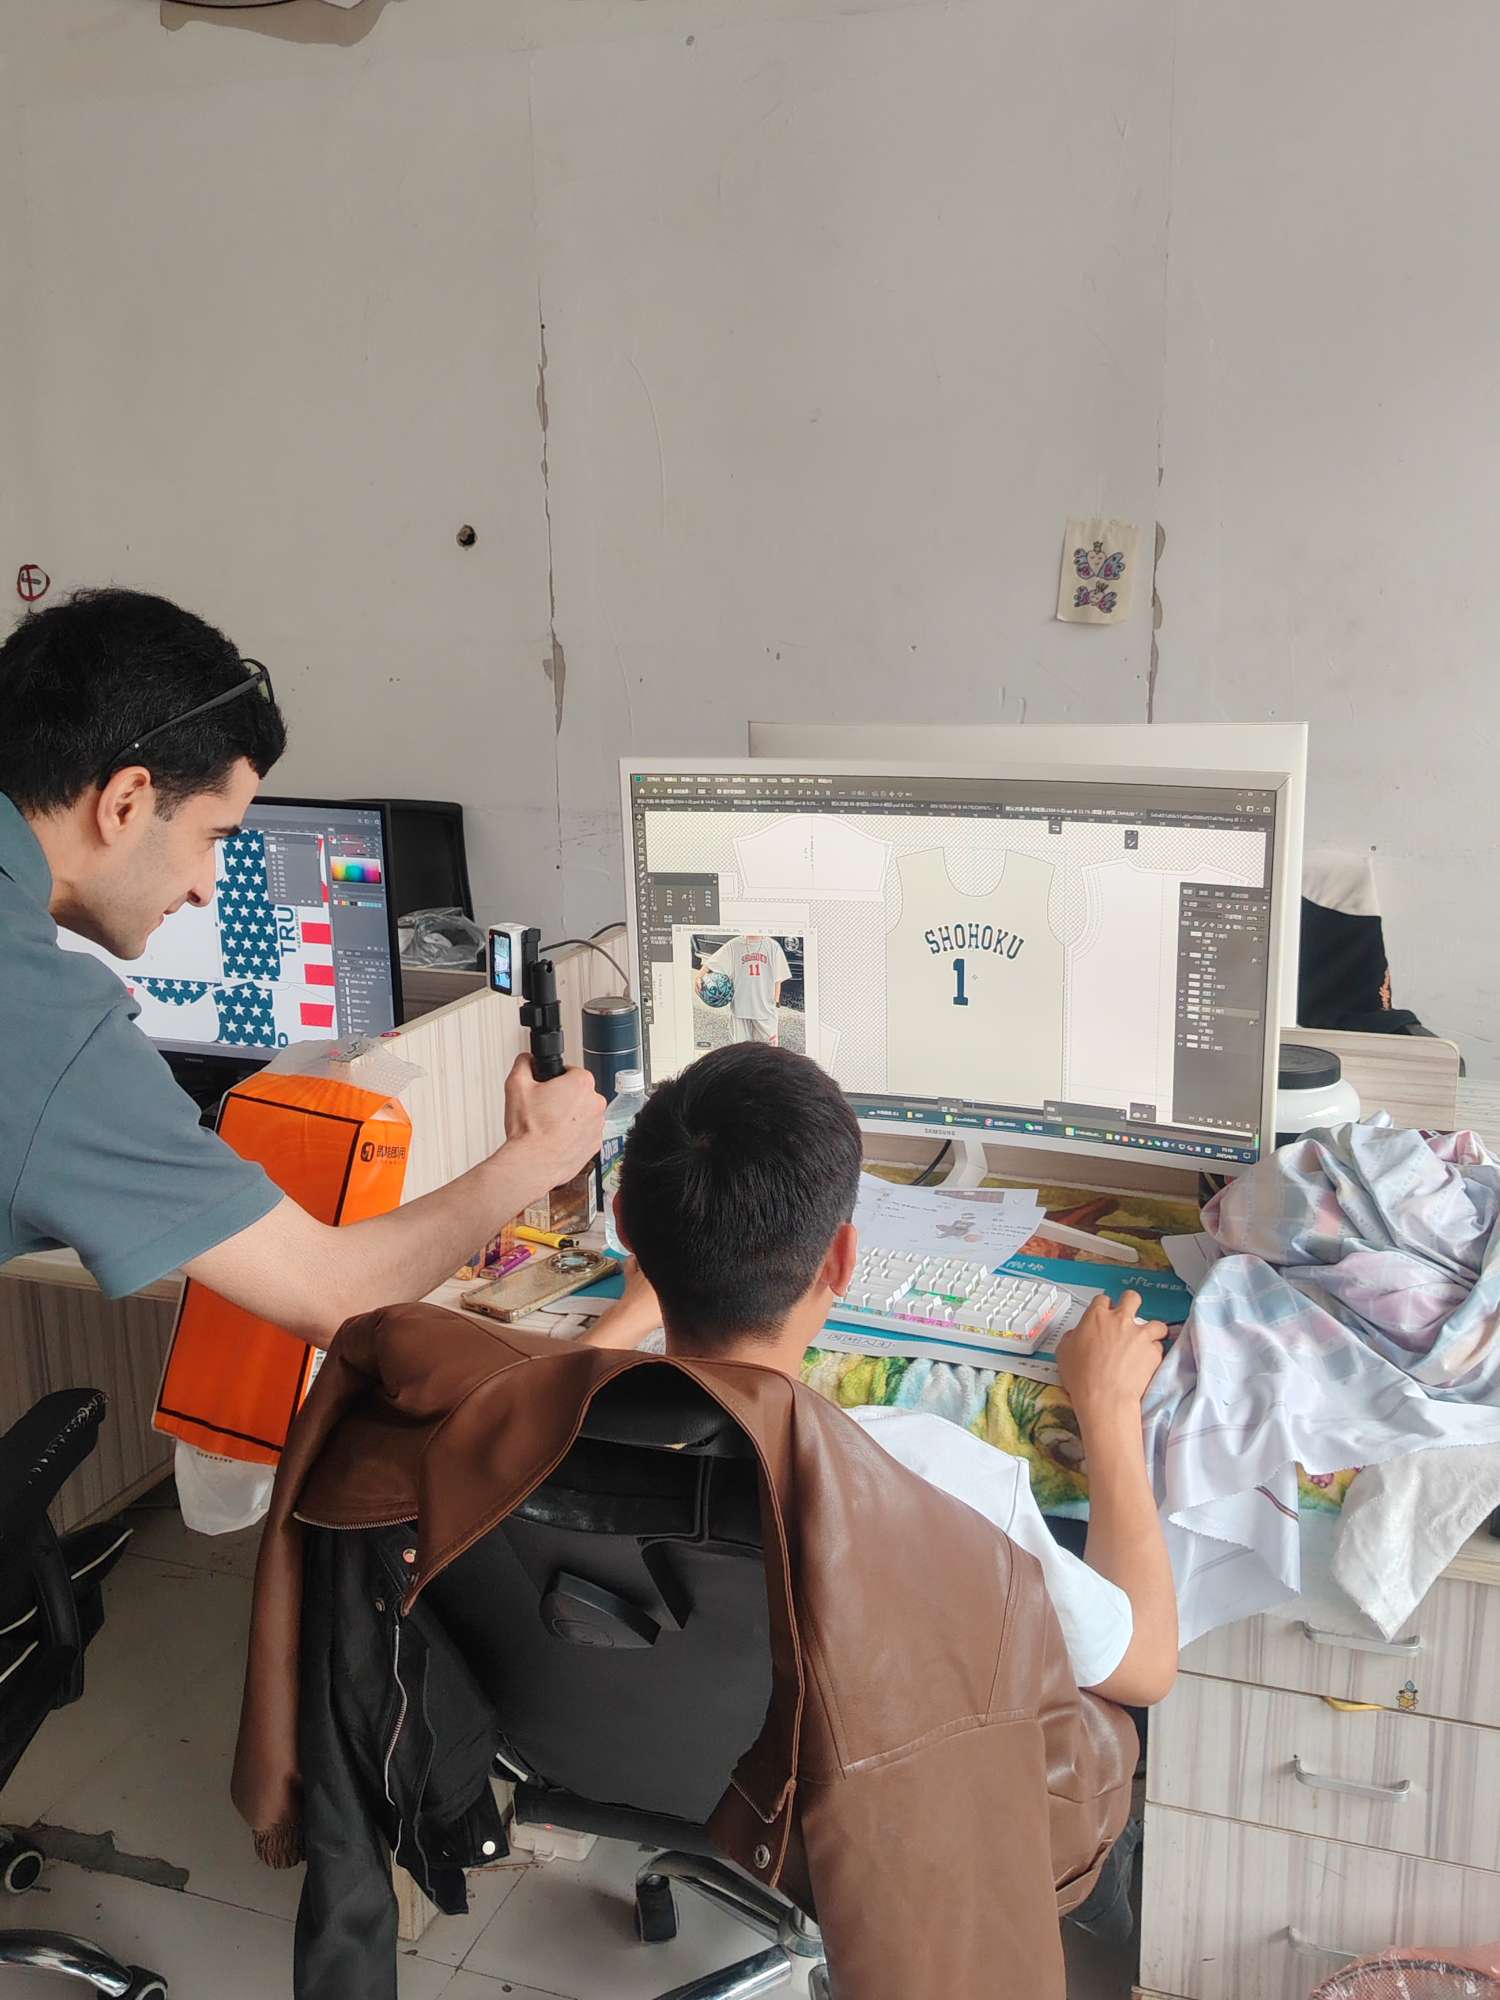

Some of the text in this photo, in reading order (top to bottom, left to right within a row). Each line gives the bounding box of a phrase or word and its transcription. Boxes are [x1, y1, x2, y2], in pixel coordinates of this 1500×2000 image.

[924, 923, 1024, 960] SHOHOKU
[748, 964, 761, 976] 11
[952, 958, 969, 1006] 1
